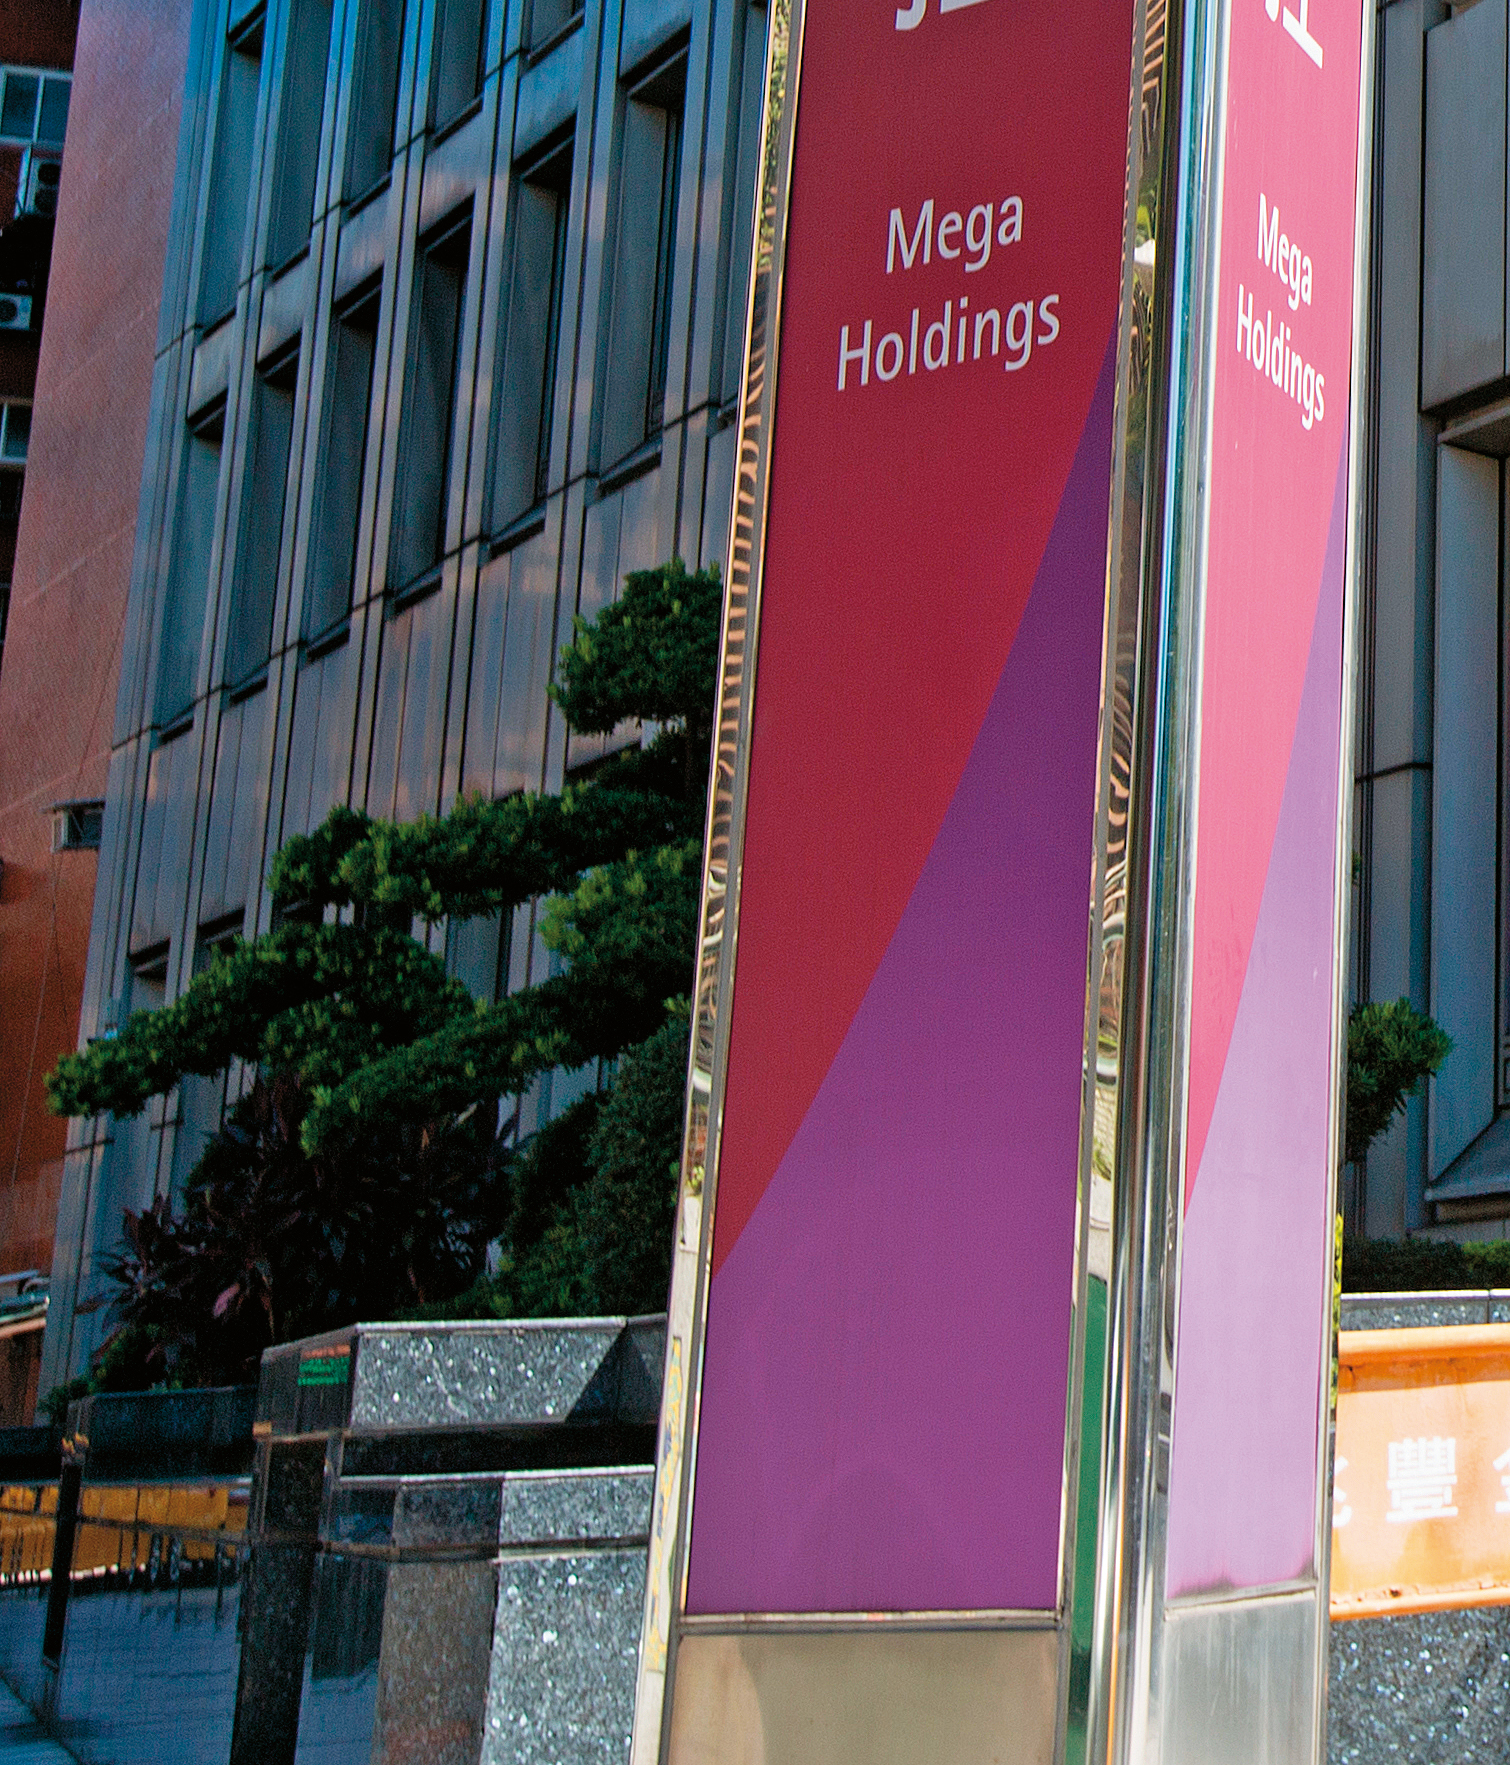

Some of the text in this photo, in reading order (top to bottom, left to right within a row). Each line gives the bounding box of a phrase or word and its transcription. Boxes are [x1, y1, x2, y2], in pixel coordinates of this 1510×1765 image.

[886, 195, 1023, 274] Mega
[1257, 193, 1313, 311] Mega
[837, 294, 1060, 391] Holdings
[1236, 283, 1325, 431] Holdings
